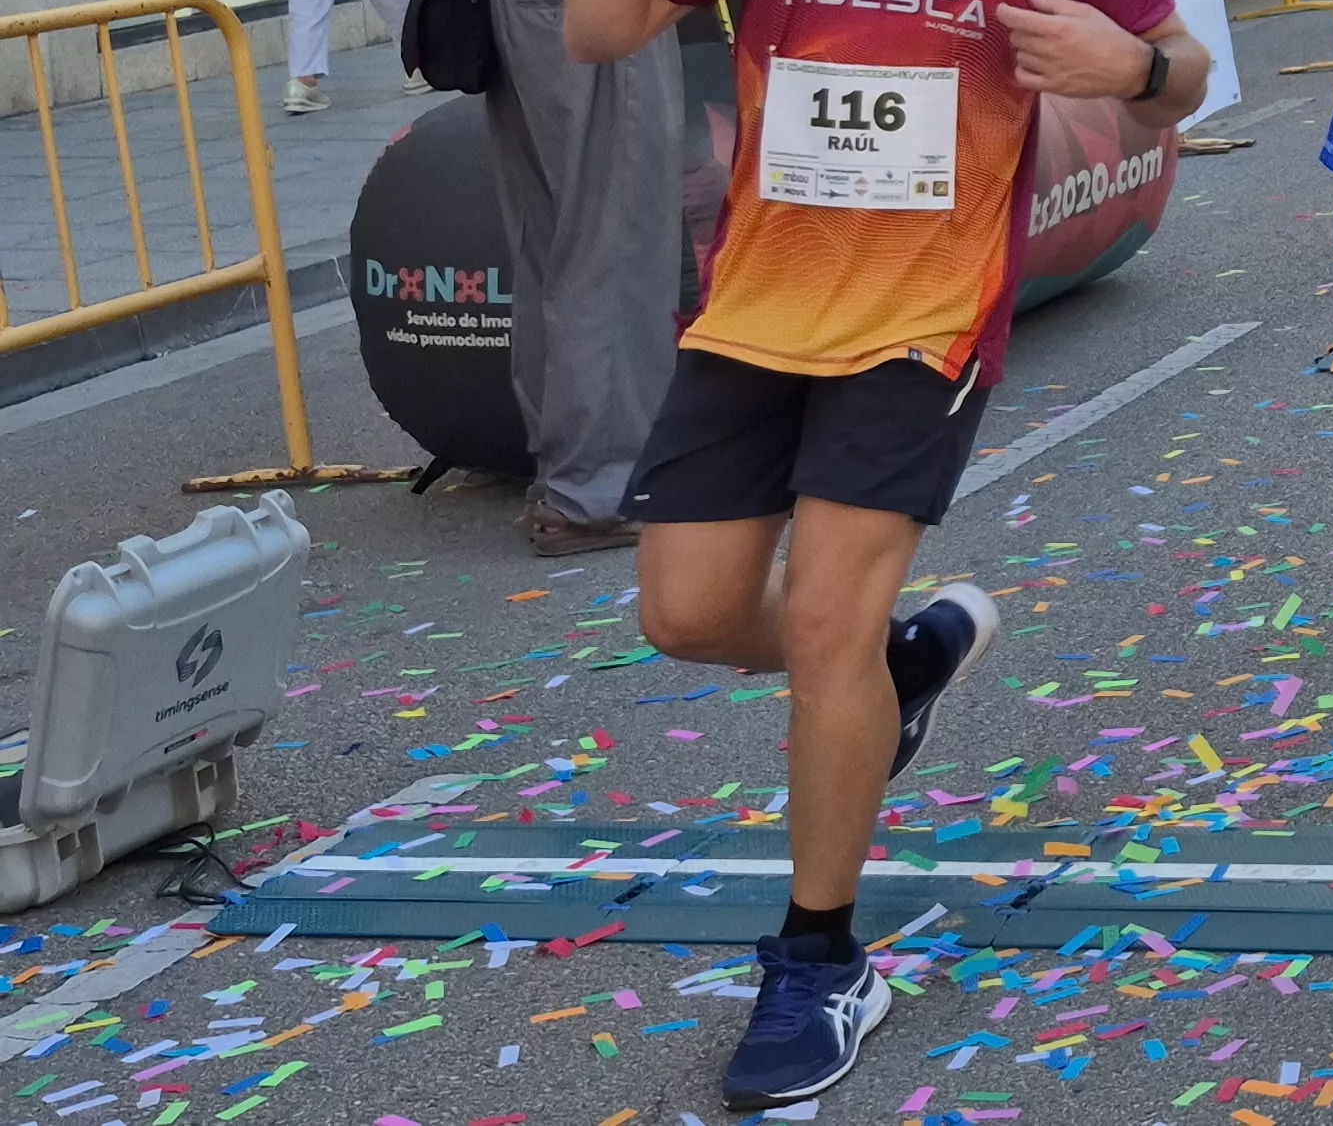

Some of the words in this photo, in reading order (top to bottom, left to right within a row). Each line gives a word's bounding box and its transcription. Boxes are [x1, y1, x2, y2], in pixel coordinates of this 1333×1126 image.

[810, 87, 907, 132] 116
[827, 133, 880, 152] RAÚL
[1028, 145, 1164, 238] ts2020.com
[406, 310, 456, 328] Servicio
[459, 313, 478, 328] de
[420, 333, 511, 348] promocional
[155, 681, 229, 723] timingsense
